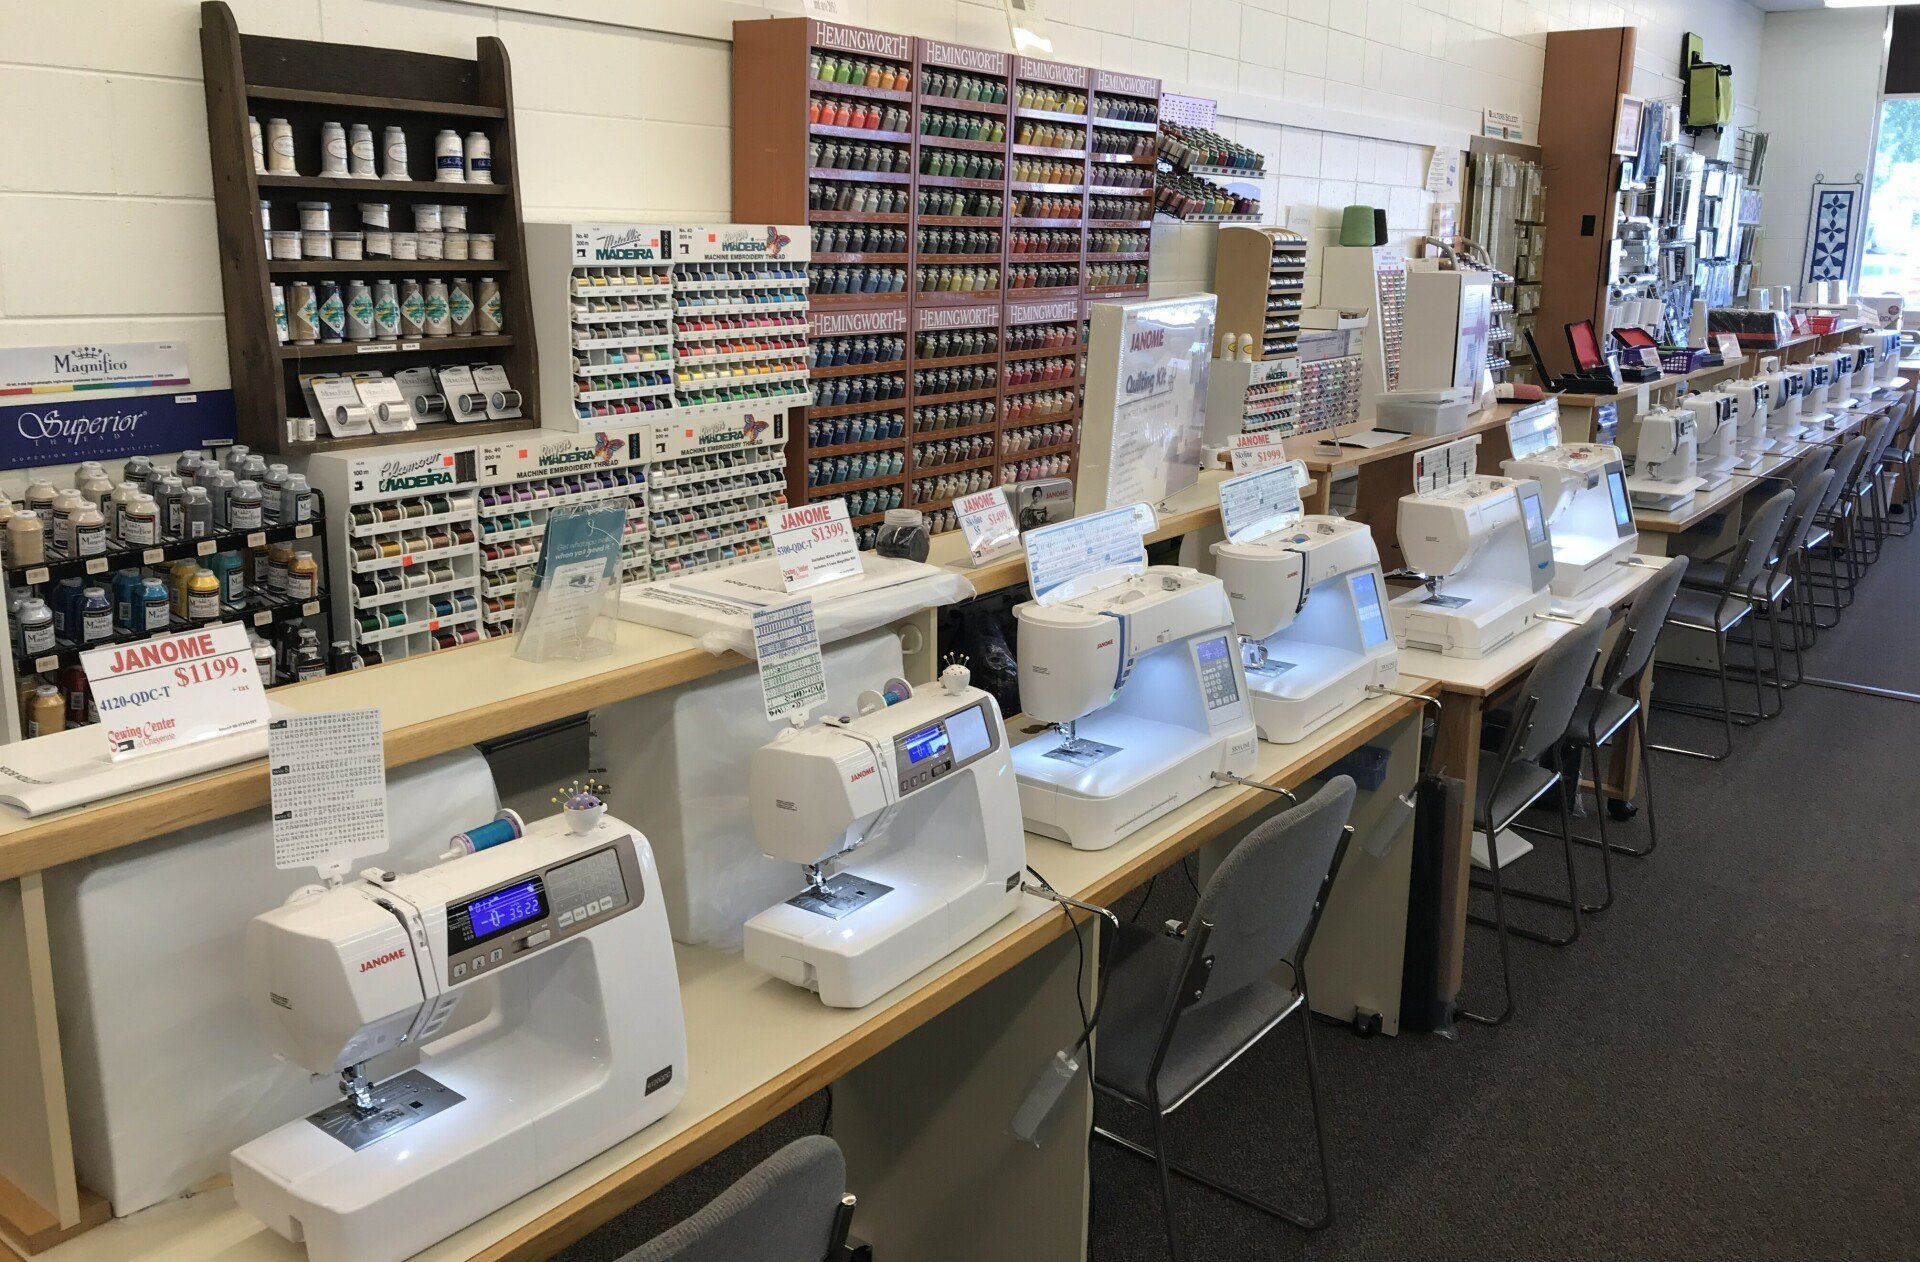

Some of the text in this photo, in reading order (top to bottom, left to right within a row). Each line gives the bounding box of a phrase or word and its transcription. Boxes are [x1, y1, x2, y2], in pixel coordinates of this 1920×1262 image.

[815, 21, 908, 59] HEMINGWORTH
[926, 41, 1004, 74] HEMINGWORTH
[1020, 57, 1086, 86] HEMINGWORTH
[1098, 71, 1156, 97] HEMINGWORTH
[596, 248, 654, 261] MADEIRA
[722, 241, 767, 252] MADEIRA
[814, 310, 902, 336] HEMINGWORTH
[920, 307, 994, 330] HEMINGWORTH
[1010, 300, 1076, 325] HEMINGWORTH
[1130, 329, 1165, 353] JANOME
[53, 352, 128, 375] Magnifico
[1126, 370, 1154, 395] Quilting
[18, 410, 142, 445] Superior
[699, 430, 744, 445] MADEIRA
[681, 439, 763, 456] MACHINE EMBROIDERY THREAD
[1237, 434, 1270, 448] JANOME
[516, 459, 619, 479] MACHINE EMBROIDERY THREAD
[538, 450, 595, 467] MADEIRA
[378, 472, 454, 493] MADEIRA
[964, 493, 995, 513] JANOME
[1045, 490, 1068, 500] JANOME
[781, 505, 831, 530] JANOME
[811, 522, 848, 543] $1399.
[777, 540, 812, 556] 5300-QDC-T
[110, 633, 216, 673] JANOME
[1096, 638, 1114, 650] JANOME
[174, 656, 248, 688] $1199.
[100, 685, 171, 711] 4120-QDC-T
[238, 684, 249, 692] tax
[108, 717, 176, 752] Sewing Center
[850, 766, 876, 783] JANOME
[359, 948, 406, 974] JANOME
